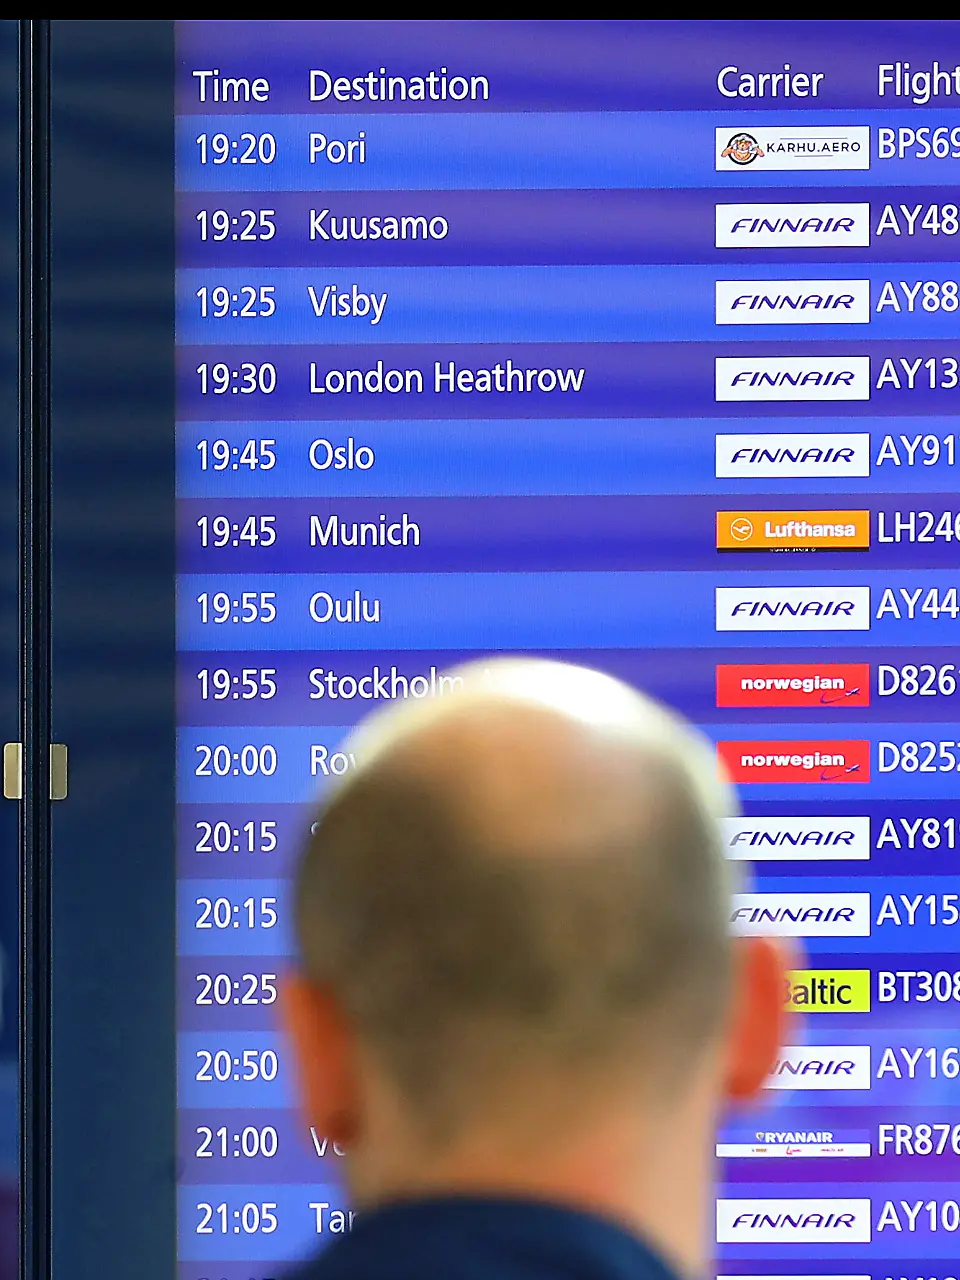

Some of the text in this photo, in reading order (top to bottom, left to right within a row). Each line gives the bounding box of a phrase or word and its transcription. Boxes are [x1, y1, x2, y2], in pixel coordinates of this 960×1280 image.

[192, 69, 270, 102] Time
[310, 67, 489, 101] Destination
[717, 64, 824, 97] Carrier
[878, 61, 960, 105] Flight
[196, 133, 276, 164] 19:20
[310, 131, 365, 164] Pori
[766, 137, 861, 153] KARHU.AERO
[196, 209, 276, 241] 19:25
[310, 209, 448, 240] Kuusamo
[730, 217, 855, 234] FINNAIR
[876, 204, 959, 236] AY48
[196, 286, 275, 318] 19:25
[307, 284, 388, 325] Visby
[730, 294, 855, 310] FINNAIR
[876, 280, 959, 312] AY88
[196, 362, 276, 394] 19:30
[310, 360, 585, 393] London Heathrow
[730, 371, 855, 387] FINNAIR
[876, 357, 958, 389] AY13
[197, 439, 276, 470] 19:45
[309, 437, 374, 470] Oslo
[730, 447, 855, 464] FINNAIR
[876, 434, 954, 466] AY91
[197, 516, 276, 547] 19:45
[310, 513, 420, 546] Munich
[764, 520, 857, 538] Lufthansa
[197, 592, 276, 623] 19:55
[309, 590, 380, 623] Oulu
[731, 601, 855, 617] FINNAIR
[876, 588, 960, 619] AY44
[197, 669, 276, 700] 19:55
[741, 676, 845, 693] norwegian
[878, 664, 956, 696] D826
[195, 745, 277, 776] 20:00
[741, 752, 845, 770] norwegian
[195, 821, 277, 852] 20:15
[729, 830, 856, 846] FINNAIR
[876, 817, 955, 849] AY81
[195, 897, 277, 929] 20:15
[729, 907, 856, 923] FINNAIR
[876, 894, 959, 926] AY15
[195, 974, 277, 1005] 20:25
[196, 1050, 278, 1081] 20:50
[876, 1047, 960, 1079] AY16
[196, 1126, 278, 1157] 21:00
[765, 1132, 833, 1143] RYANAIR
[196, 1202, 278, 1234] 21:05
[732, 1213, 856, 1229] FINNAIR
[876, 1200, 960, 1232] AY10
